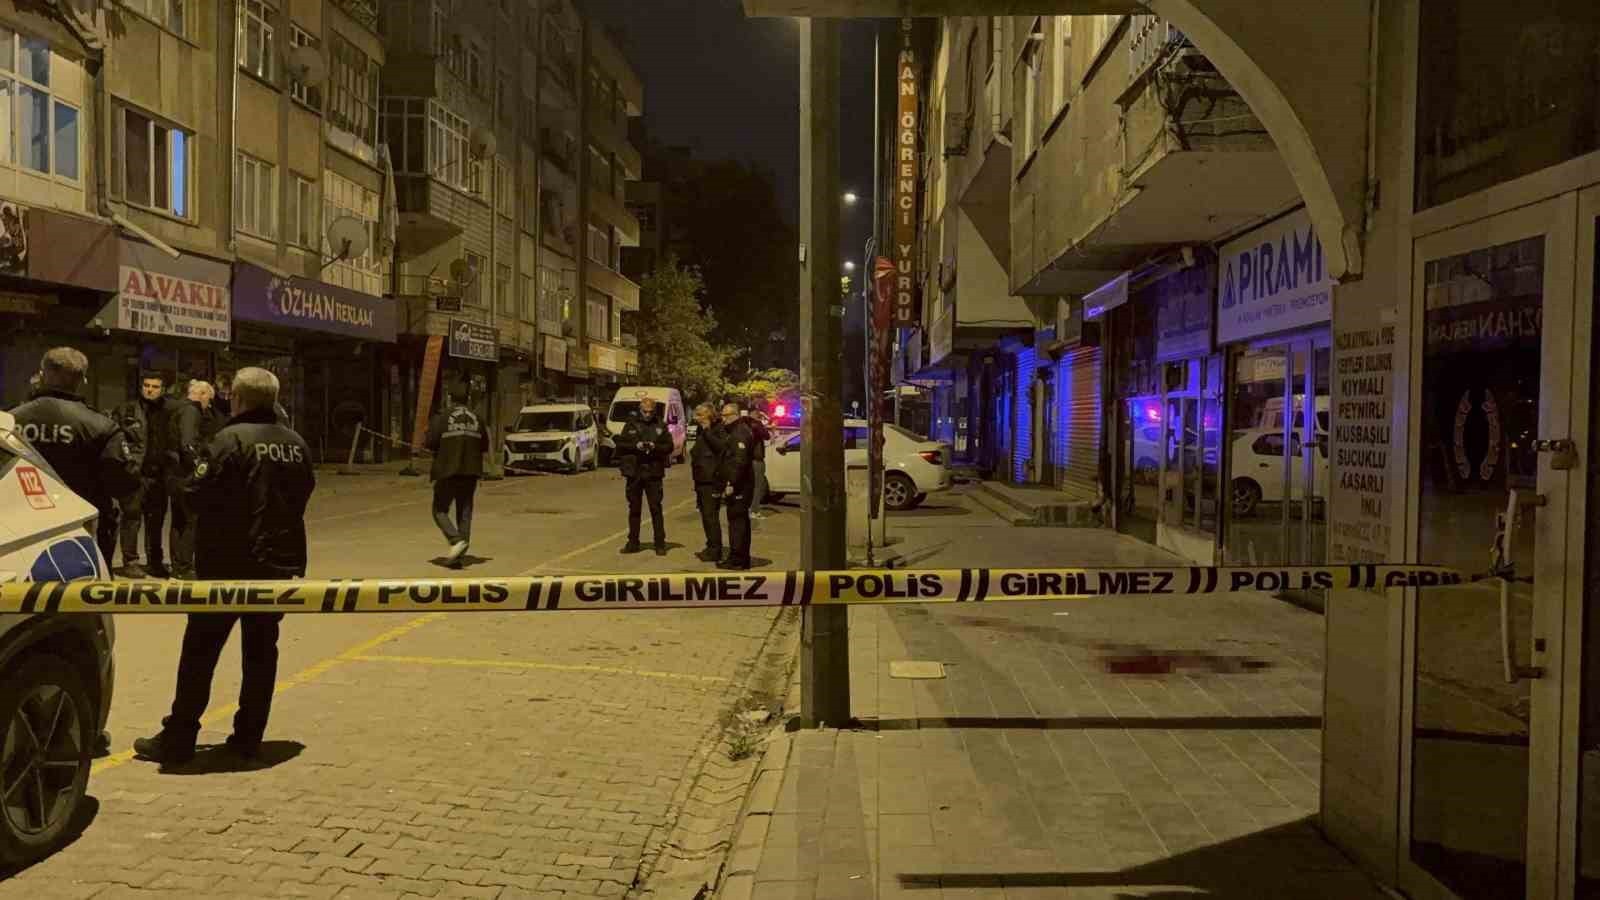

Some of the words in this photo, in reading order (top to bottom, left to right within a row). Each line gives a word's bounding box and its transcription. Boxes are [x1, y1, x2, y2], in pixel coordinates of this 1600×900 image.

[901, 111, 914, 225] ÖĞRENCİ
[281, 279, 334, 321] ÖZHAN
[336, 303, 374, 328] REKLAM
[897, 244, 912, 321] YURDU
[1337, 448, 1386, 469] SUCUKLU
[20, 471, 43, 492] 112
[80, 582, 305, 606] GİRİLMEZ
[574, 575, 769, 602] GİRİLMEZ
[829, 572, 943, 599] POLİS
[1000, 570, 1175, 597] GİRİLMEZ
